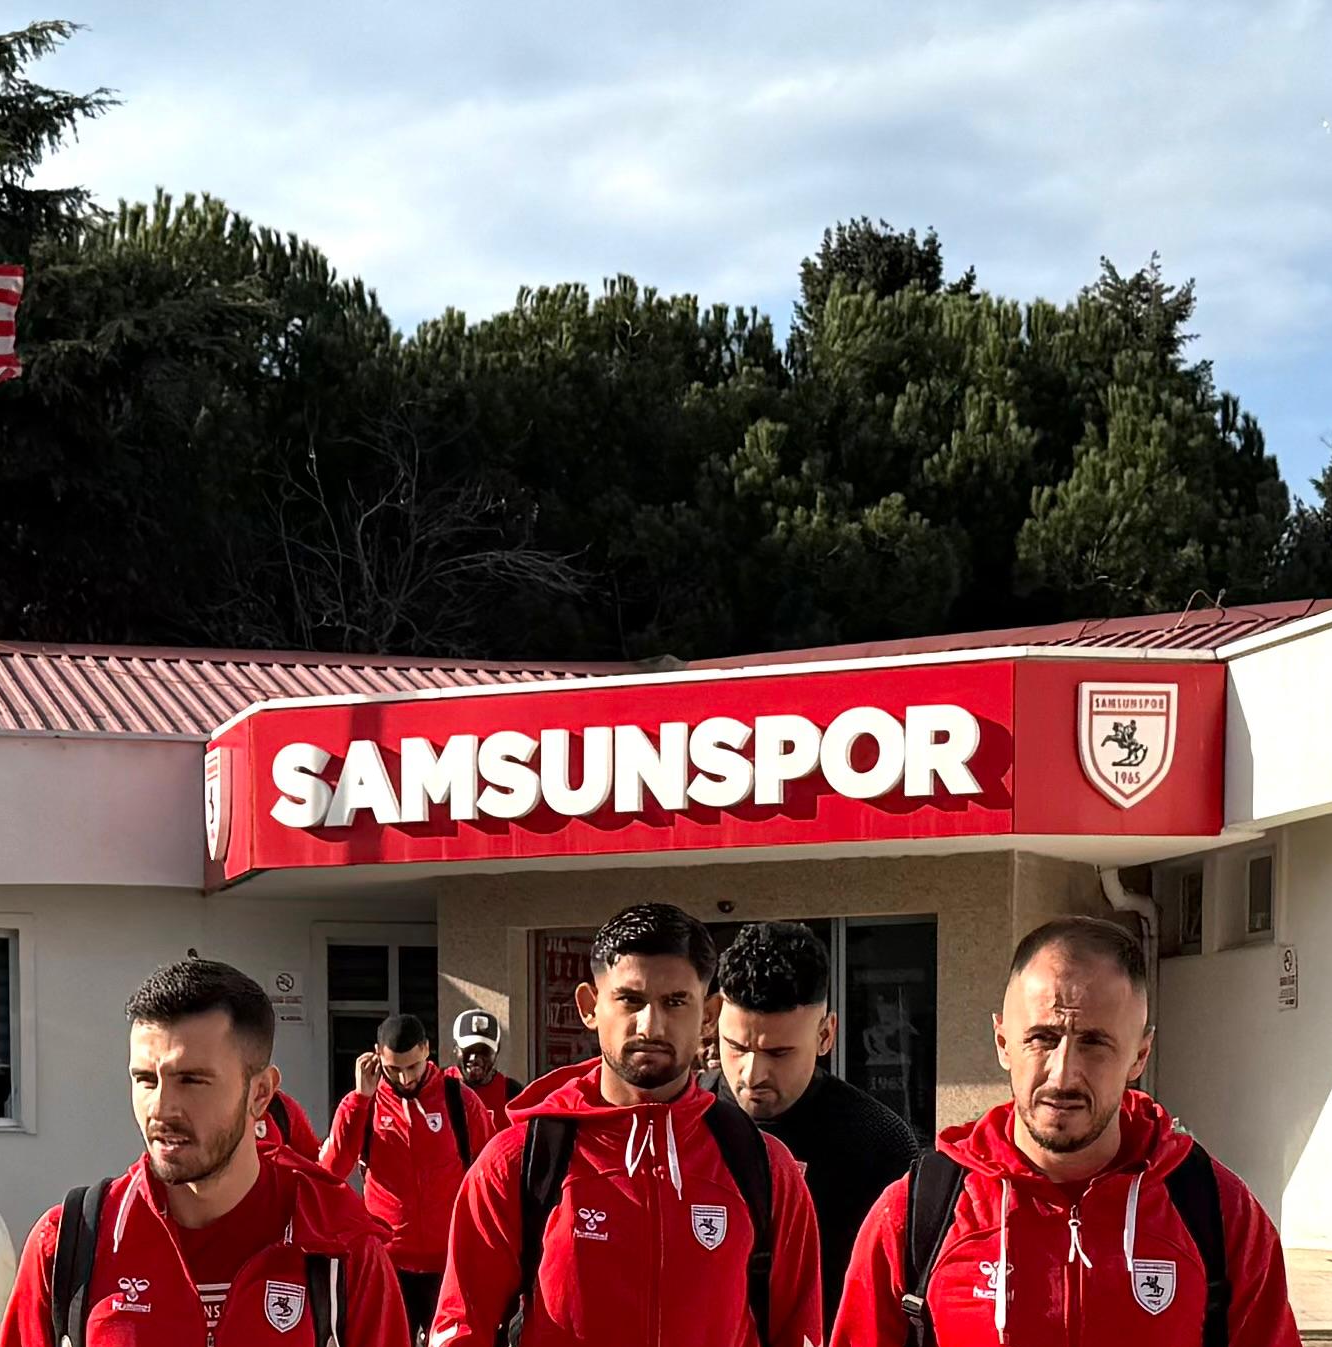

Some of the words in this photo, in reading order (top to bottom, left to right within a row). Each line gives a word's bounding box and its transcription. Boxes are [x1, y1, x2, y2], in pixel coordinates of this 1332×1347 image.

[1095, 698, 1165, 709] SAMSUNSPOR
[270, 704, 983, 829] SAMSUNSPOR
[1114, 770, 1142, 785] 1965
